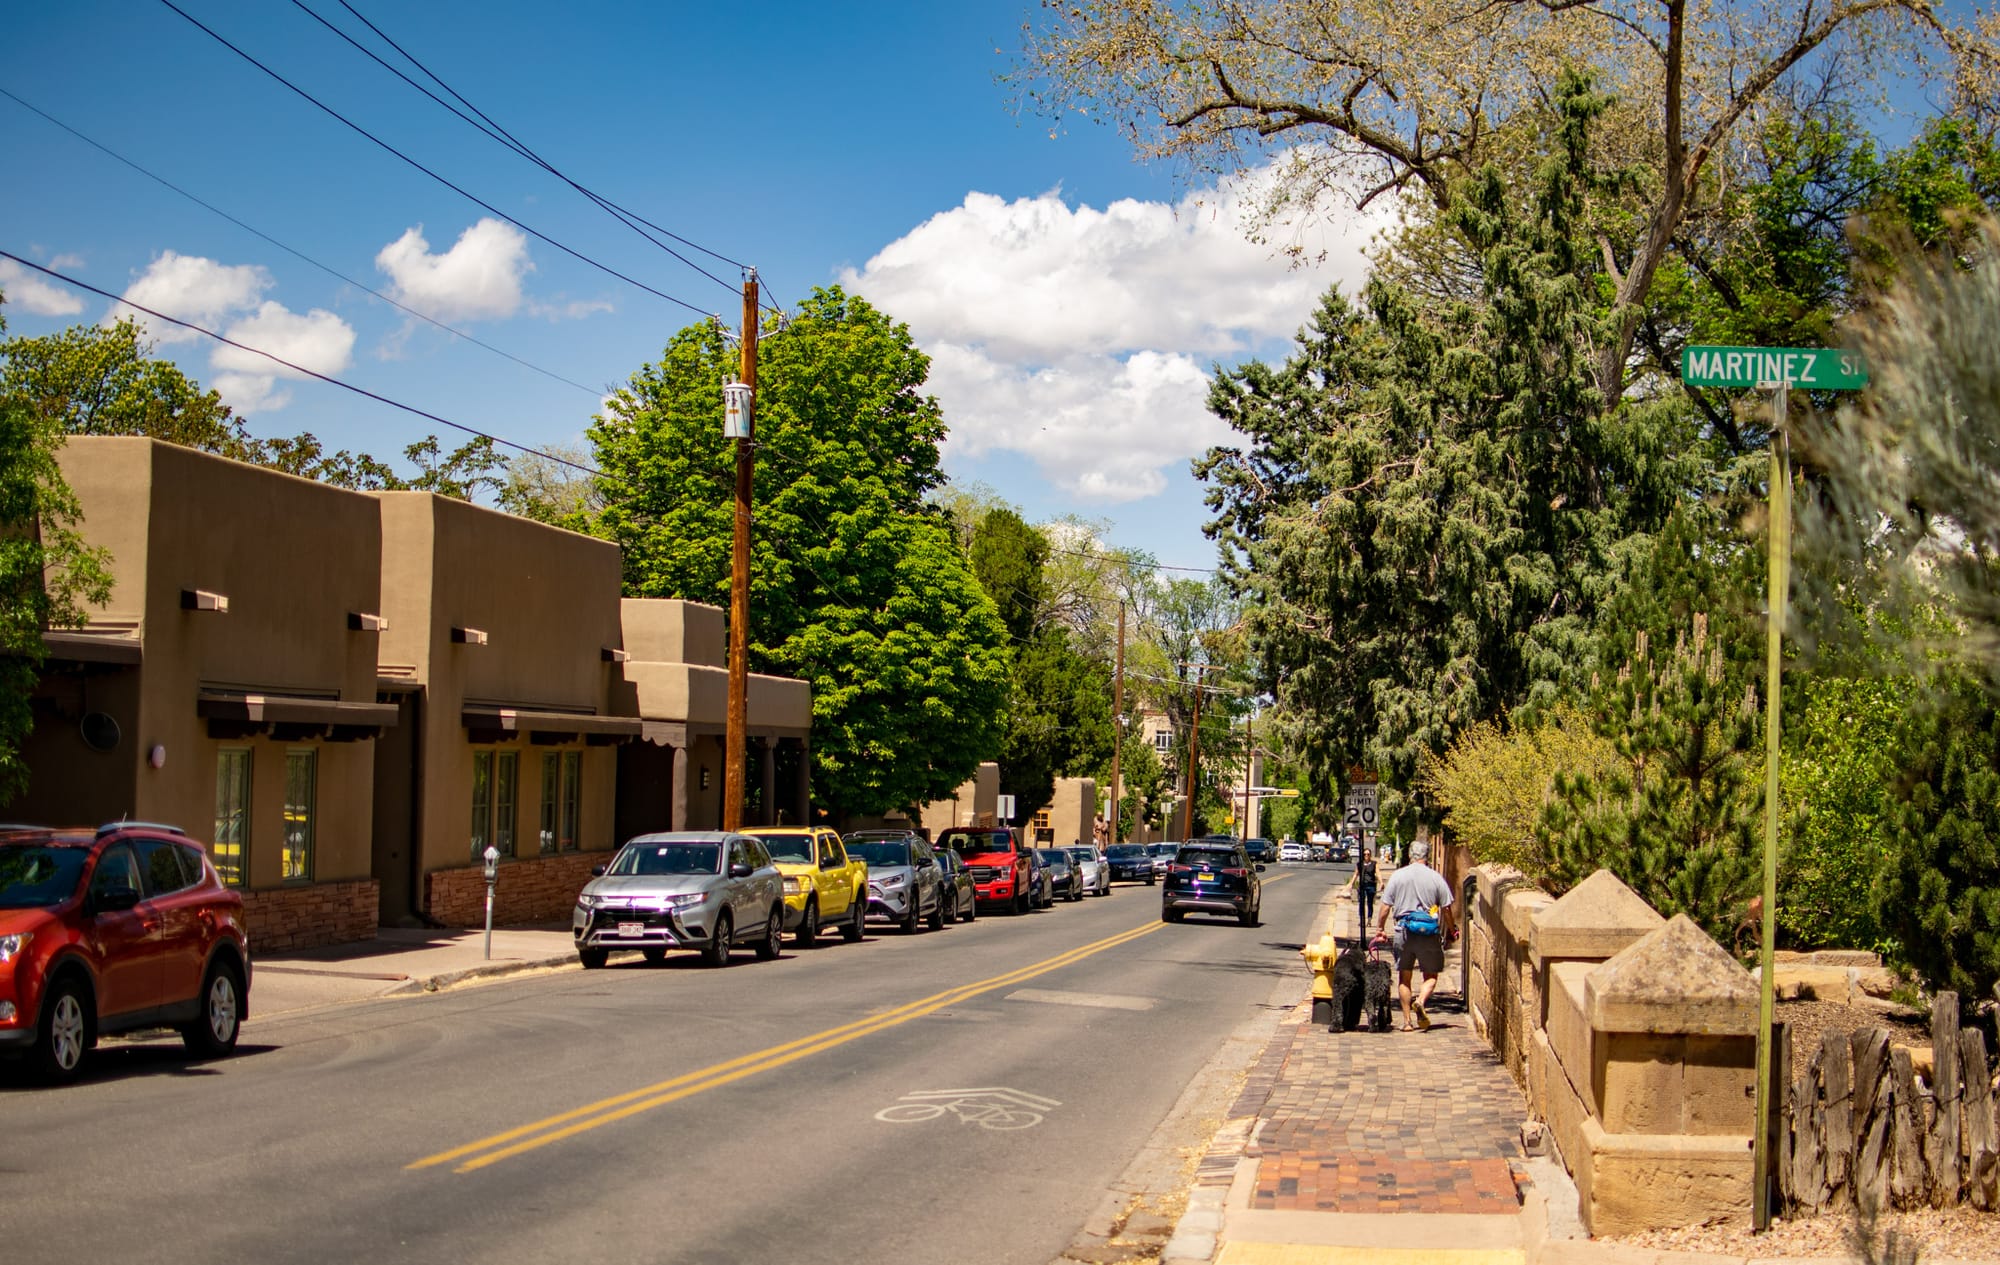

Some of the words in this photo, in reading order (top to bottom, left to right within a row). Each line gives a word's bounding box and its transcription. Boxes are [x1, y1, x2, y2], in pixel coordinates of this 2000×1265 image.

[1688, 351, 1817, 382] MARTINEZ
[1840, 355, 1861, 376] ST
[1347, 807, 1375, 824] 20
